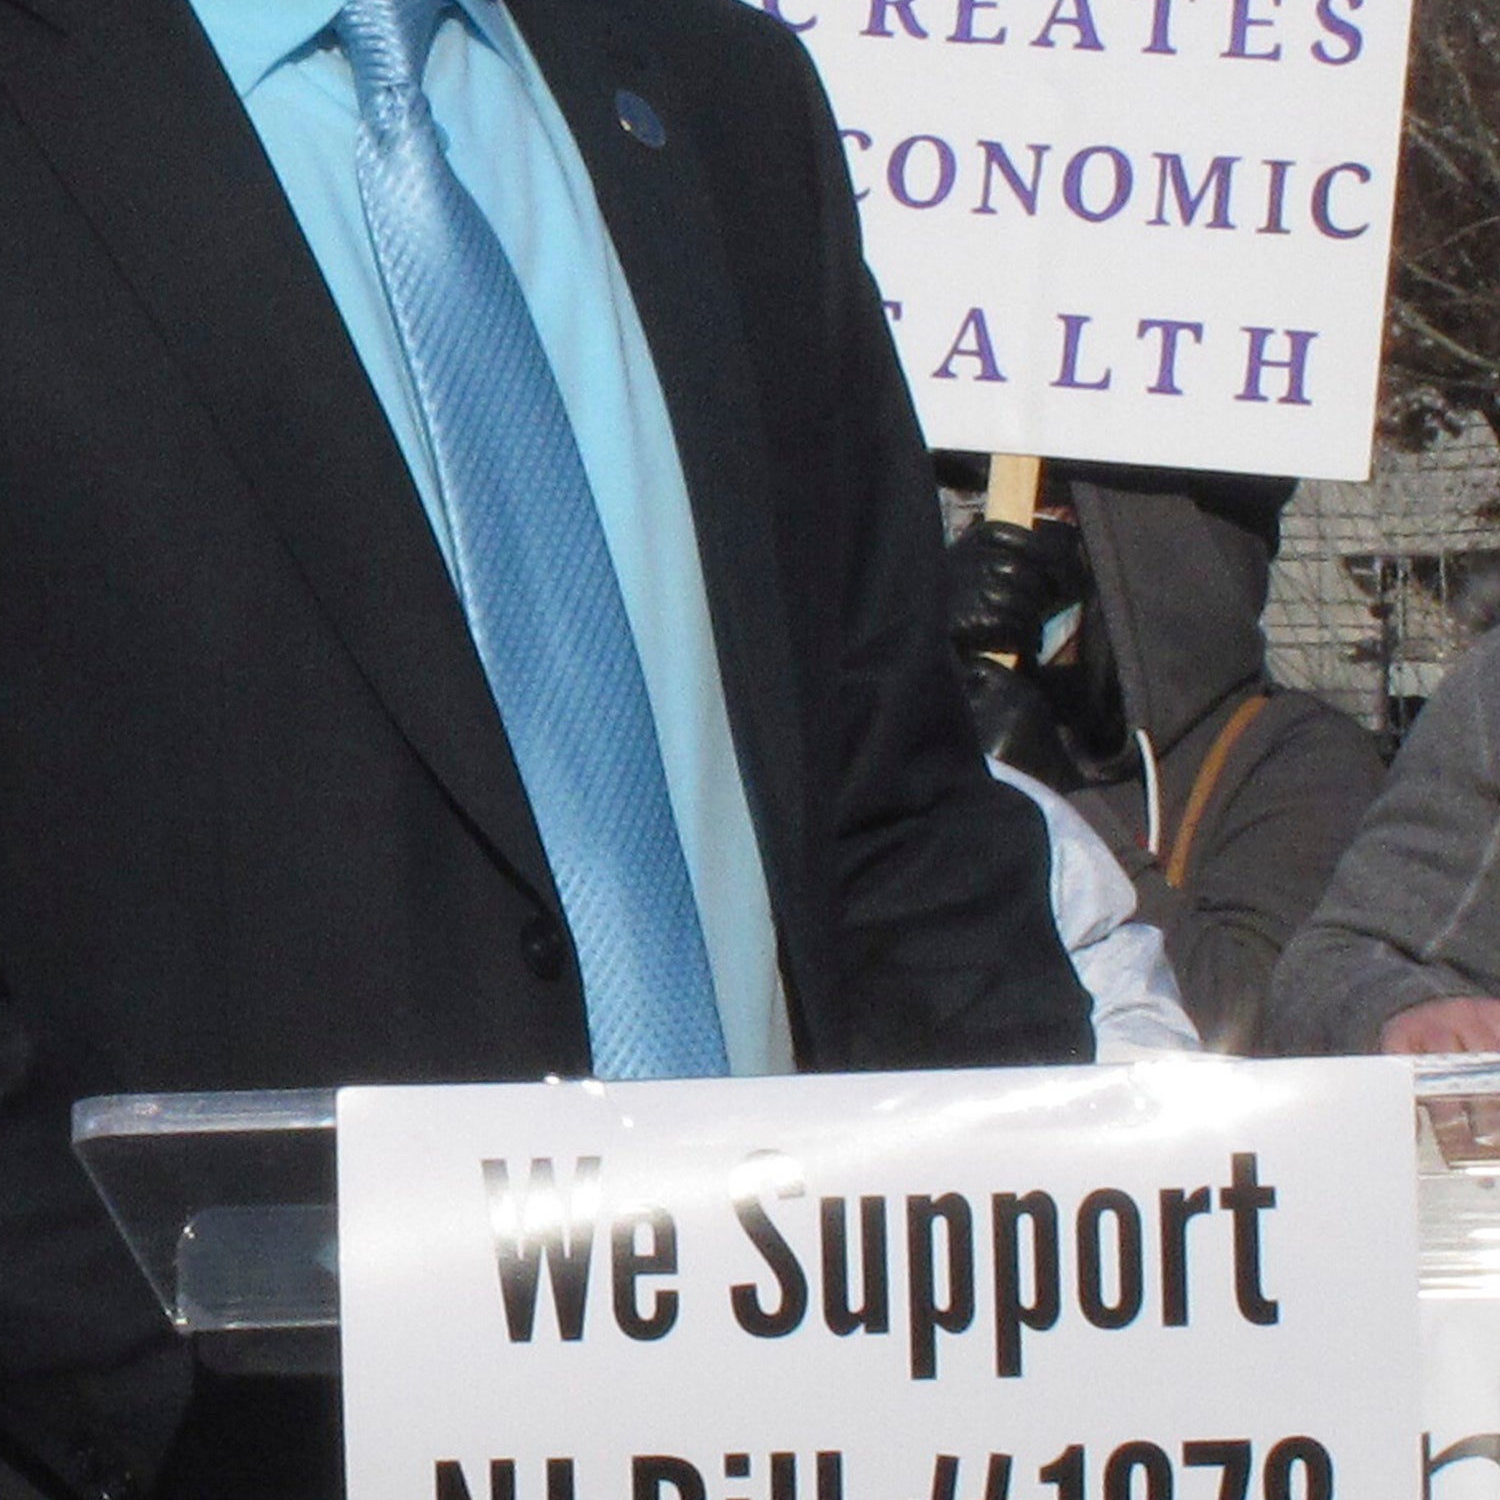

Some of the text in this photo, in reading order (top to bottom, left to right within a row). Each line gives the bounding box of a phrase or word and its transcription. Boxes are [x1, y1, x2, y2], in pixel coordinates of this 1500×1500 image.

[838, 128, 1372, 240] ONOMIC
[881, 298, 1319, 406] ALTH
[481, 1147, 1280, 1381] We Support
